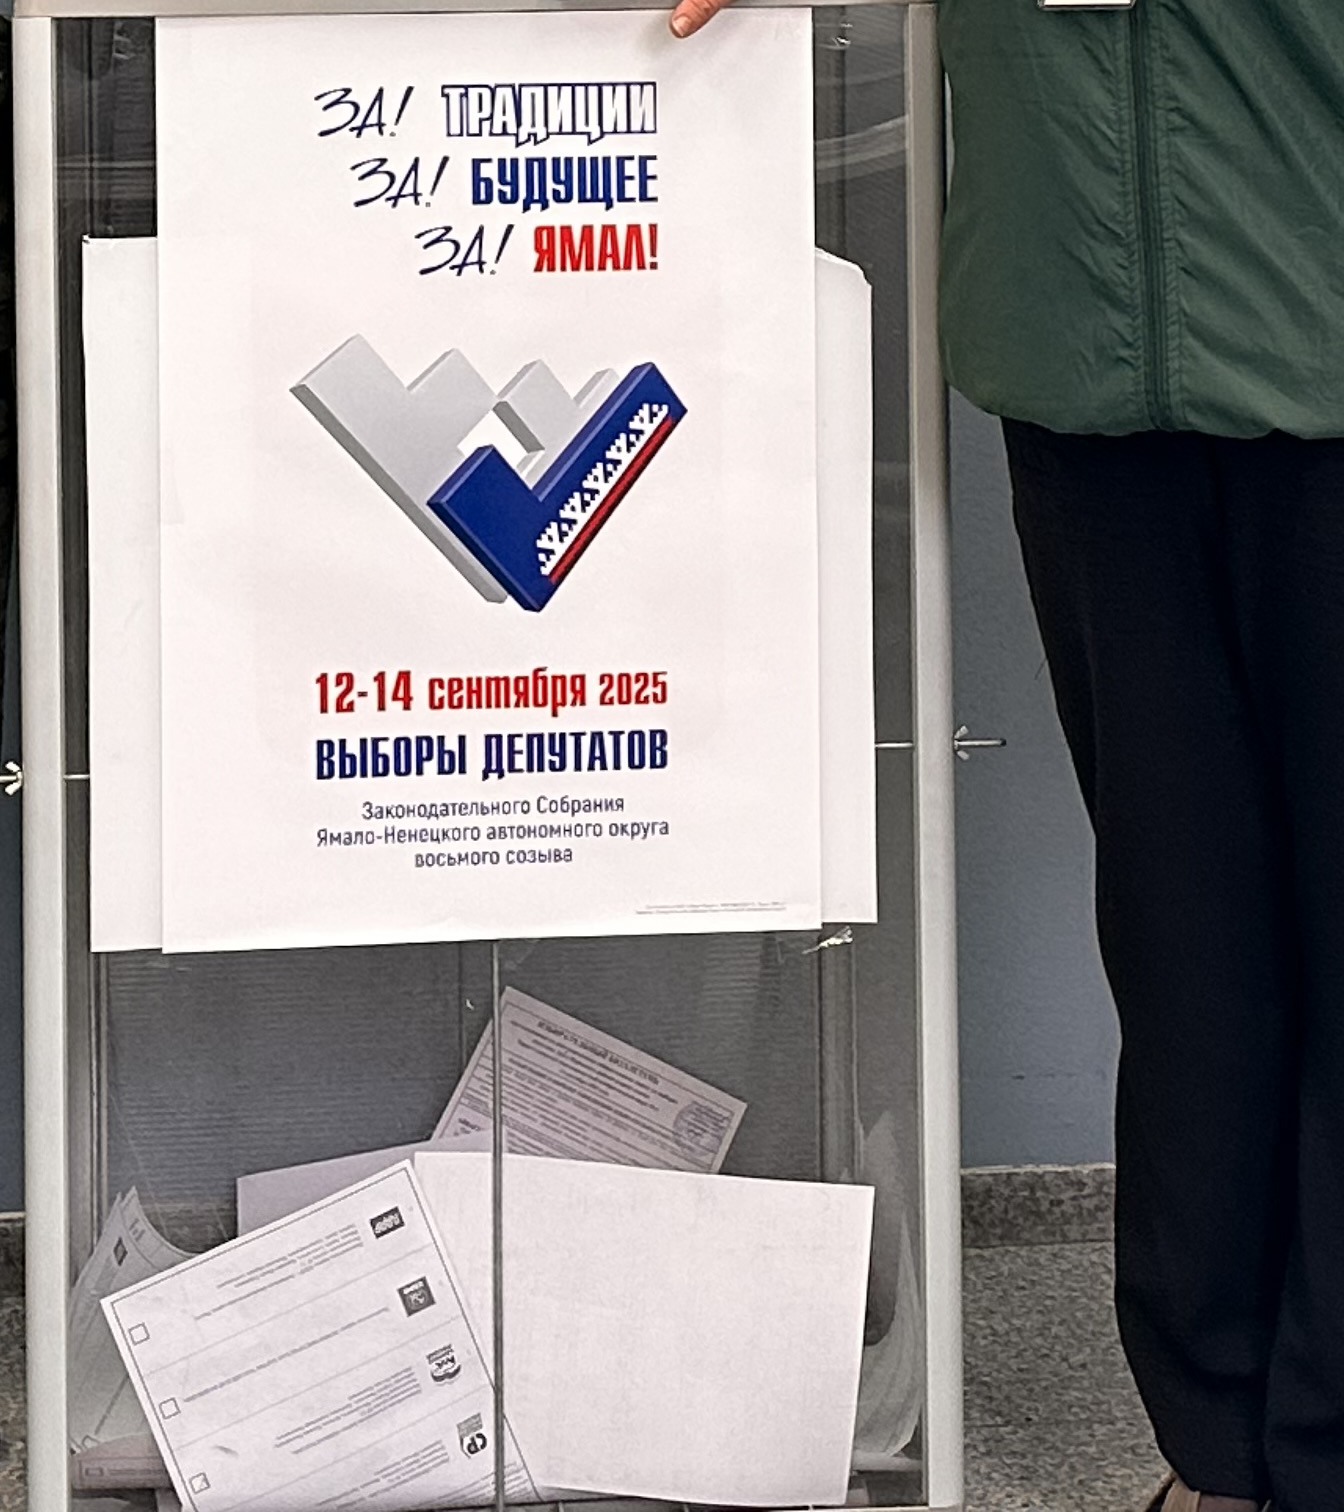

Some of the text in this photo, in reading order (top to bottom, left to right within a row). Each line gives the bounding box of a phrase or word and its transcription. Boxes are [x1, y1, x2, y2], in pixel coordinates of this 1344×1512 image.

[314, 81, 658, 148] ЗА! ТРАДИЦИИ
[350, 155, 658, 213] ЗА! БУДУЩЕЕ
[414, 224, 658, 276] ЗА! ЯМАЛ!
[315, 666, 668, 717] 12-14 сентября 2025
[315, 729, 669, 781] ВЫБОРЫ ДЕПУТАТОВ
[362, 795, 625, 821] Законодательного Собрания
[316, 821, 670, 847] Ямало-Ненецкого автономного округа
[414, 847, 573, 868] восьмого созыва
